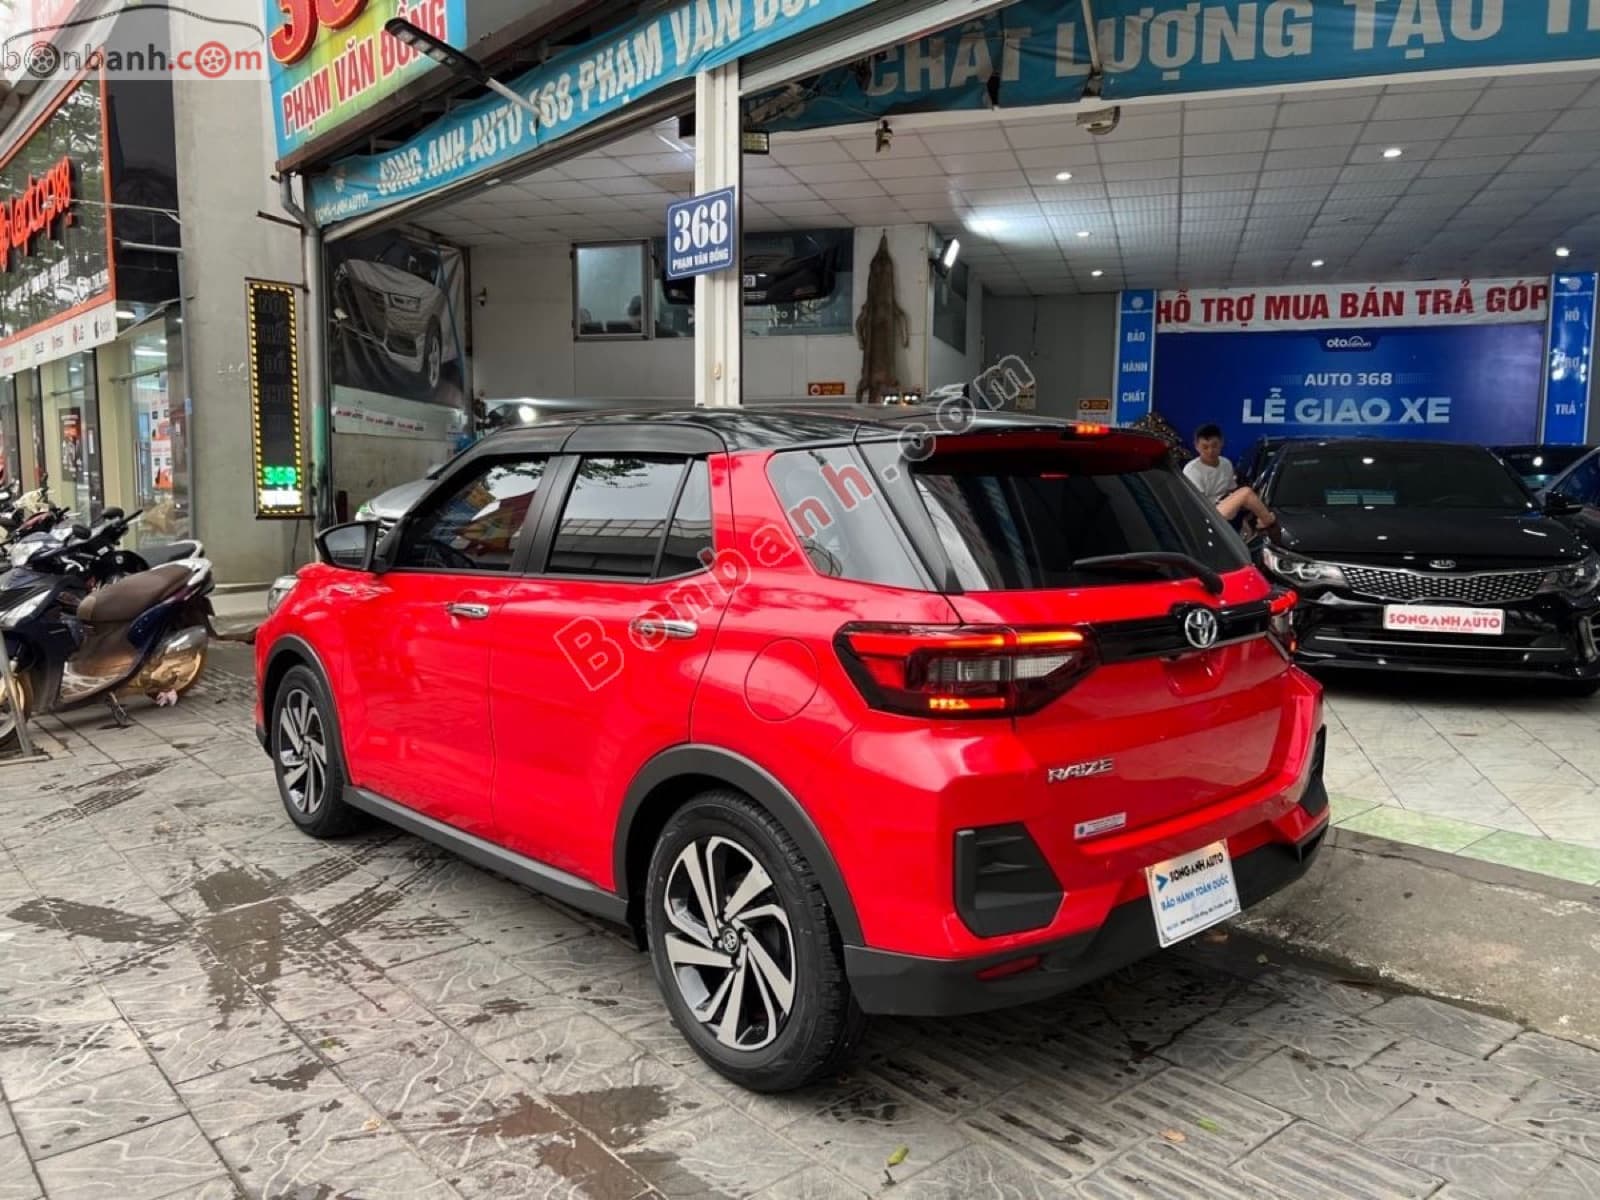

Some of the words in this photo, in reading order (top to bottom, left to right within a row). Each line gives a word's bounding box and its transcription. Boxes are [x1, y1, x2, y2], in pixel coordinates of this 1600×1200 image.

[1055, 0, 1313, 80] LƯỢNG
[282, 67, 332, 139] PHẠM
[333, 36, 376, 104] VĂN
[425, 126, 465, 179] ANH
[468, 102, 522, 162] AUTO
[578, 32, 663, 112] PHẠM
[674, 199, 728, 253] 368
[1157, 286, 1191, 324] HỖ
[1201, 294, 1256, 327] TRỢ
[1264, 294, 1329, 321] MUA
[1340, 286, 1404, 318] BÁN
[1415, 279, 1474, 315] TRẢ
[1486, 280, 1548, 312] GÓP
[1304, 373, 1352, 386] AUTO
[1357, 372, 1392, 385] 368
[1242, 387, 1287, 424] LỄ
[1294, 397, 1391, 424] GIAO
[1400, 397, 1451, 424] XE
[1048, 758, 1113, 783] RAIZE
